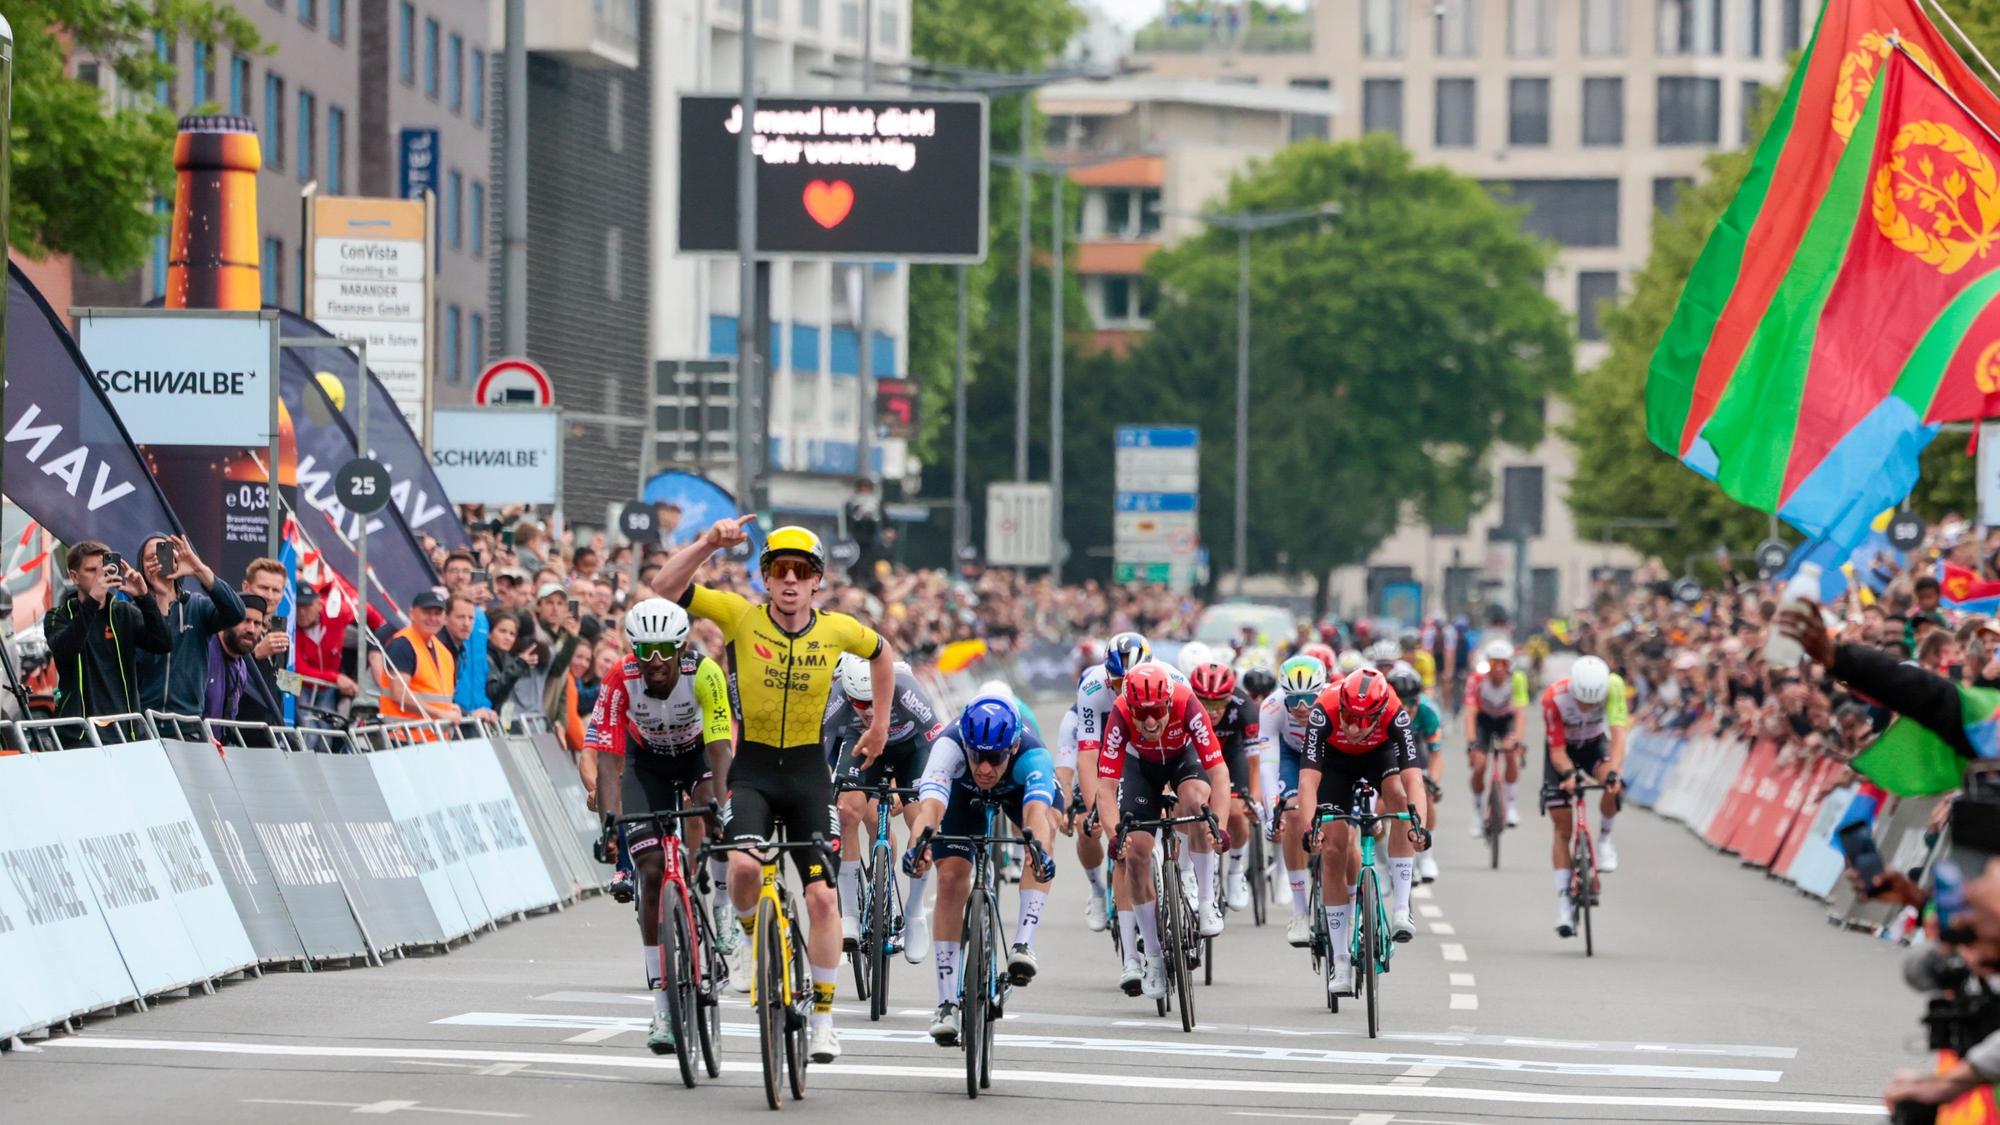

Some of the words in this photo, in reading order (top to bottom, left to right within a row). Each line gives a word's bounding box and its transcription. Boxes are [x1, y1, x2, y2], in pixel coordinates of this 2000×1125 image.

[724, 104, 821, 135] Jmand
[407, 131, 432, 200] OTEL
[340, 243, 399, 261] ConVista
[340, 284, 398, 298] NARANDER
[327, 301, 374, 315] Finanzen
[377, 302, 411, 316] GmbH
[96, 370, 245, 395] SCHWALBE
[432, 449, 539, 467] SCHWALBE
[350, 476, 376, 496] 25
[628, 512, 650, 530] 50
[1895, 522, 1919, 540] 50
[764, 665, 811, 681] lease
[901, 688, 933, 722] Alpecin
[1083, 706, 1095, 734] BOSS
[1306, 728, 1318, 763] ARKEA
[1402, 728, 1417, 761] ARKEA
